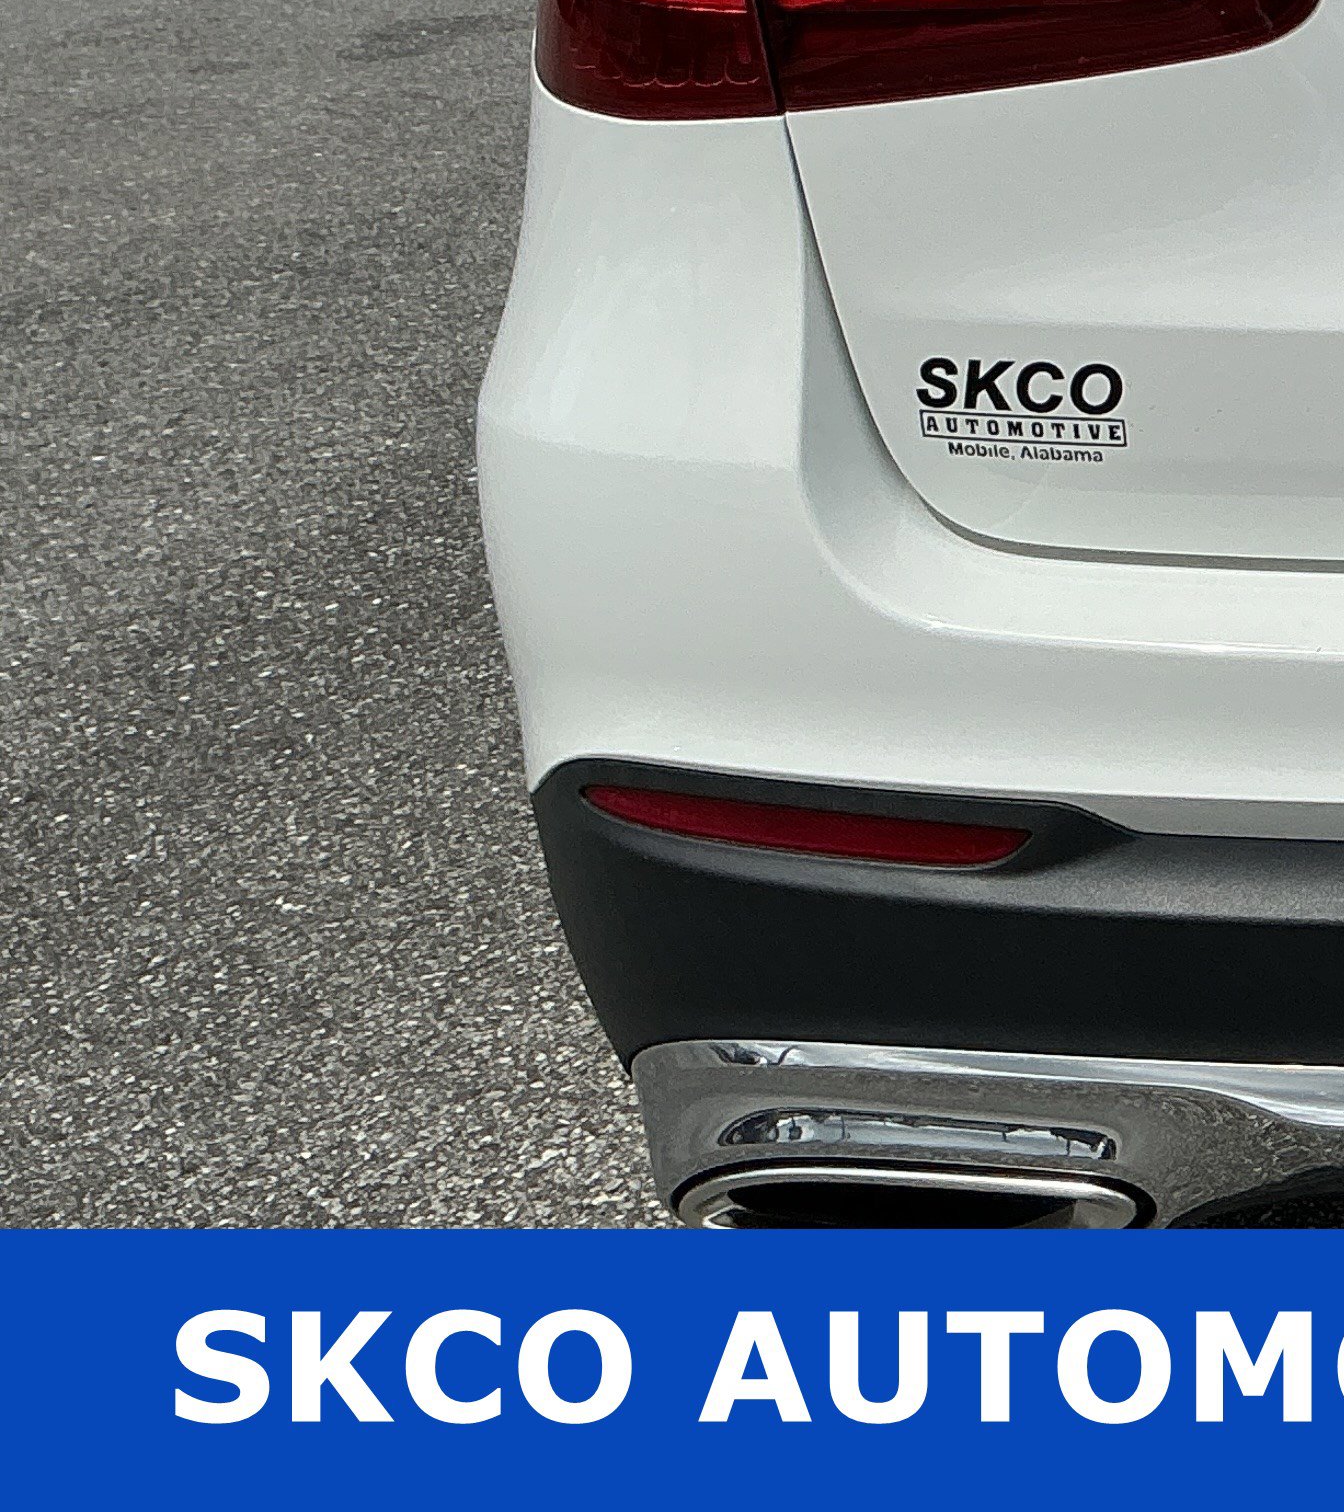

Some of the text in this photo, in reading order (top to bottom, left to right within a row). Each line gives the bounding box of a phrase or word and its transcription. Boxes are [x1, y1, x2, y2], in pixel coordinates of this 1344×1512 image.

[916, 357, 1124, 416] SKCO
[925, 415, 1122, 441] AUTOMOTIVE
[948, 442, 1104, 463] Mobile, Alabama
